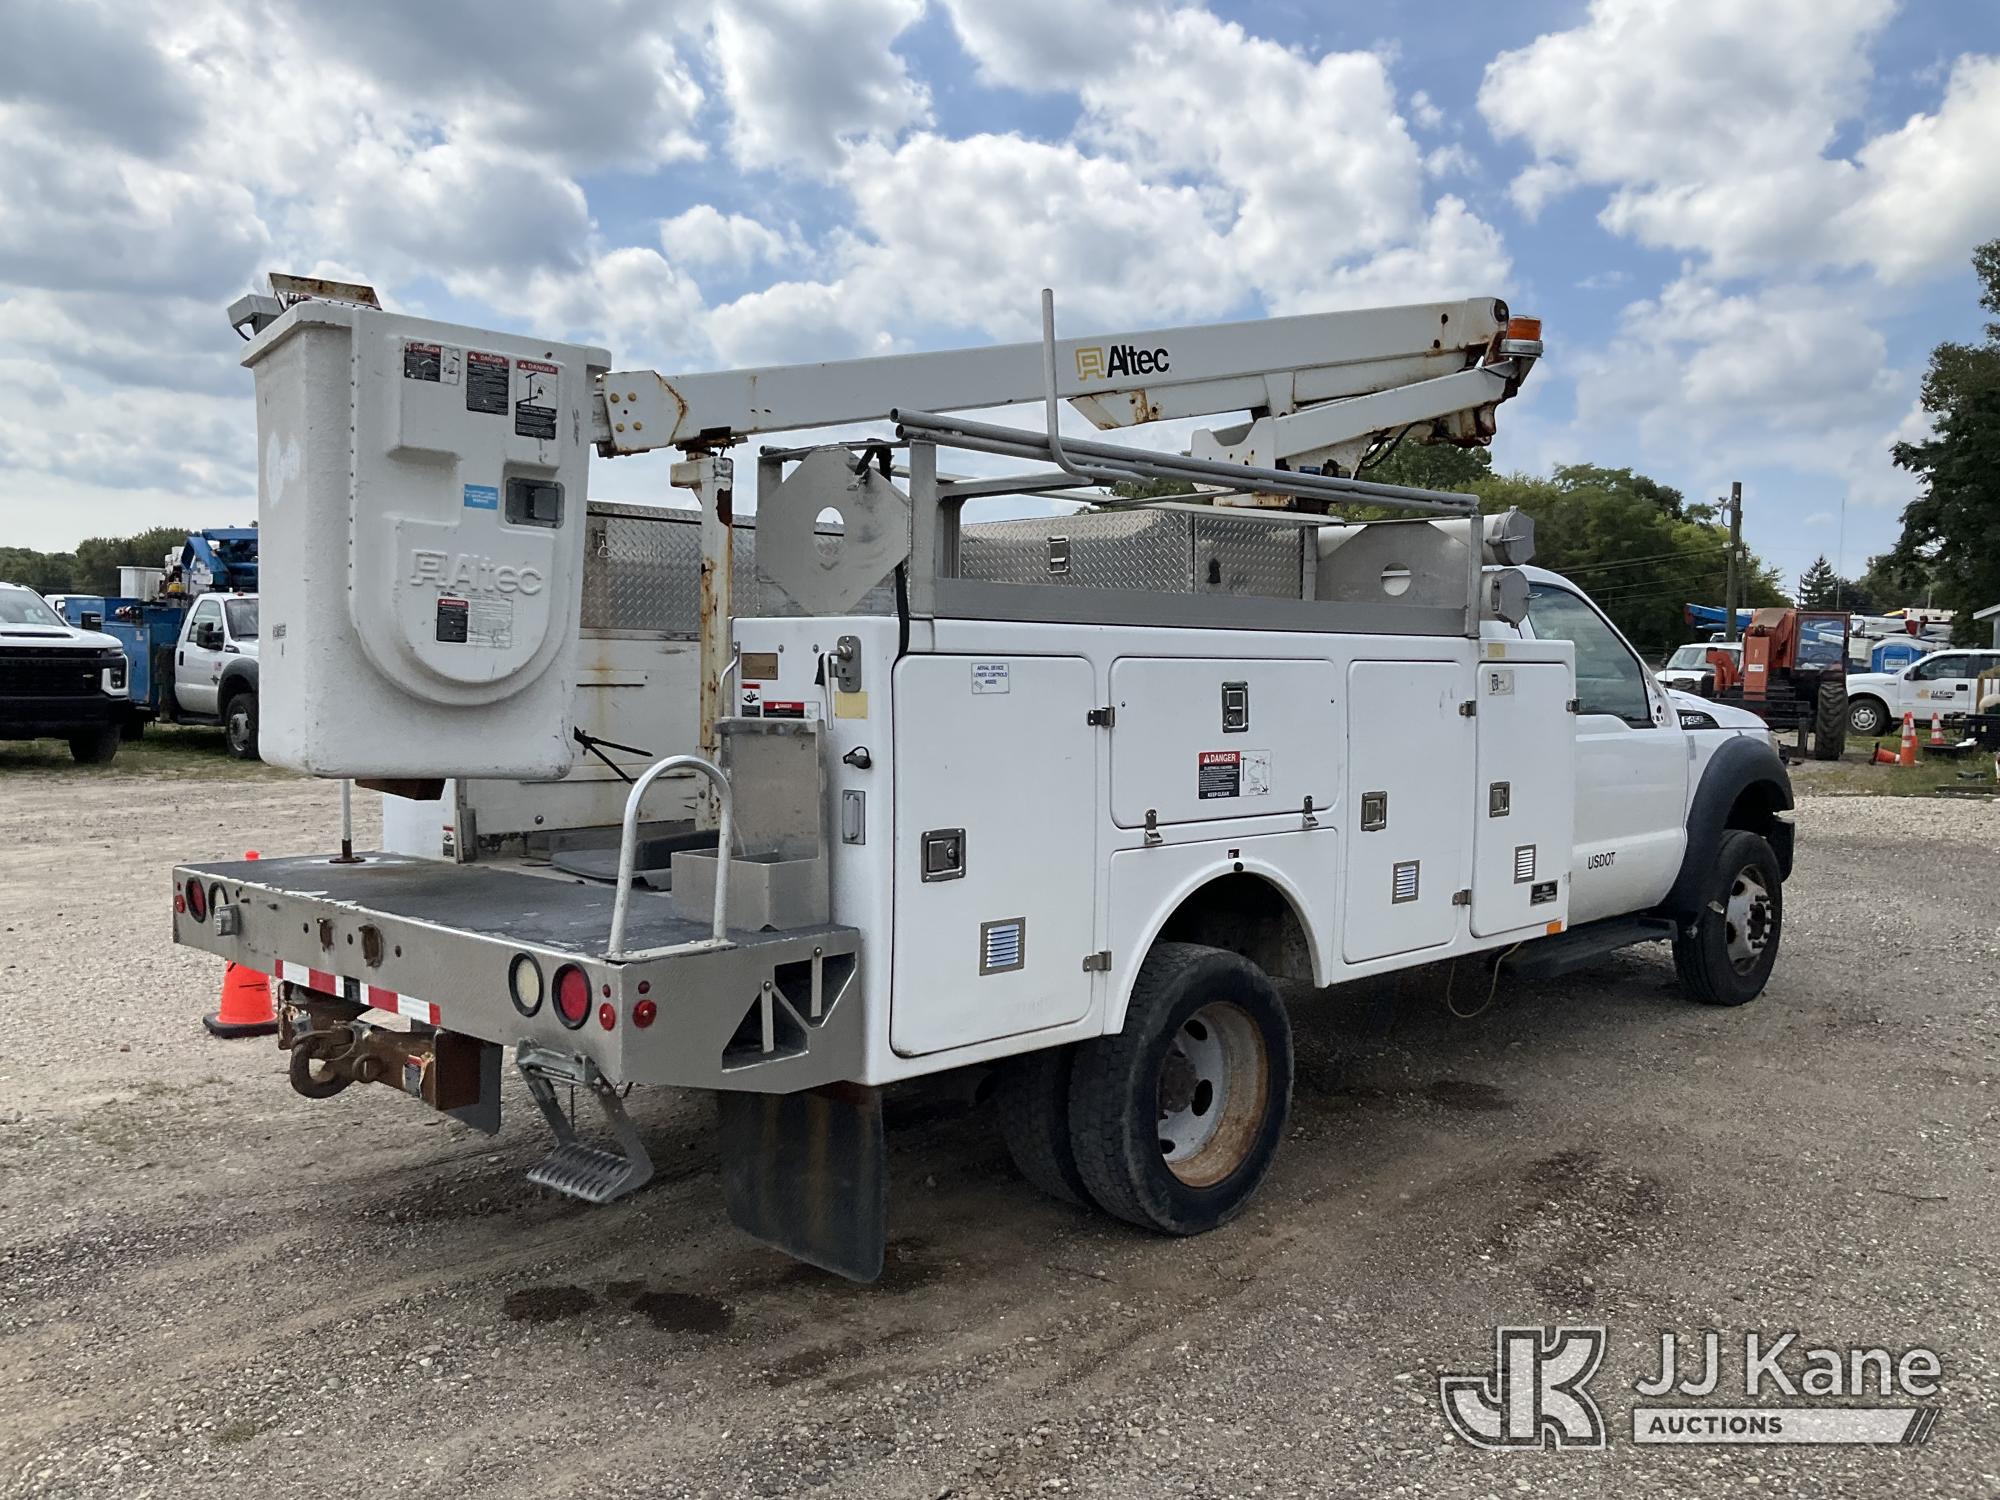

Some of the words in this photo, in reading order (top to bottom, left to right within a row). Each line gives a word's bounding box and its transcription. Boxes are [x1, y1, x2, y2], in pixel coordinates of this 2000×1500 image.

[527, 363, 556, 373] DANGER
[1107, 345, 1170, 378] Altec
[448, 553, 542, 596] Altec
[1211, 754, 1236, 762] DANGER
[1588, 851, 1616, 870] USDOT
